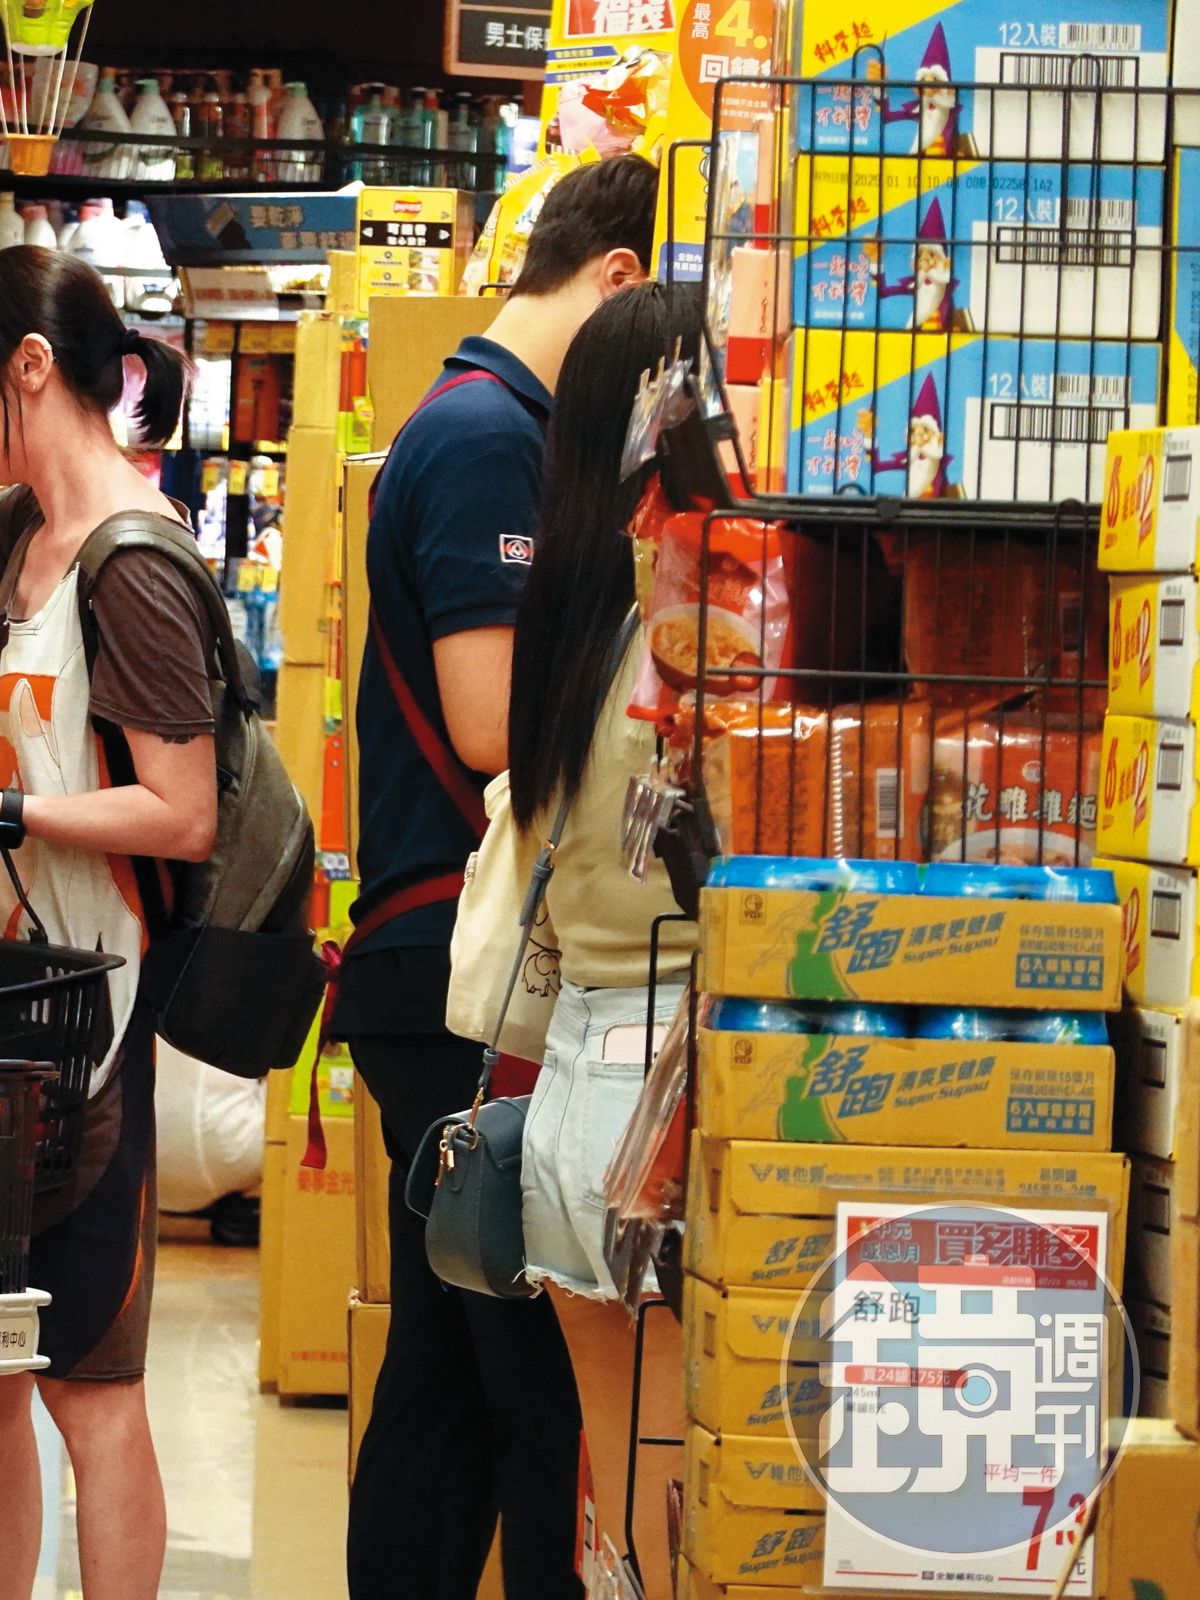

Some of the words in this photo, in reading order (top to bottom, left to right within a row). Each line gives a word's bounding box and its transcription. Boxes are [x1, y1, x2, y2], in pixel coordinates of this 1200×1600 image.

[485, 21, 550, 52] 男士保
[692, 3, 710, 39] 最高
[999, 22, 1057, 47] 12入裝
[817, 900, 905, 975] 舒跑
[807, 1044, 896, 1119] 舒跑
[860, 1242, 920, 1265] 感恩月
[853, 1290, 921, 1325] 舒跑
[984, 1463, 1058, 1485] 平均一件
